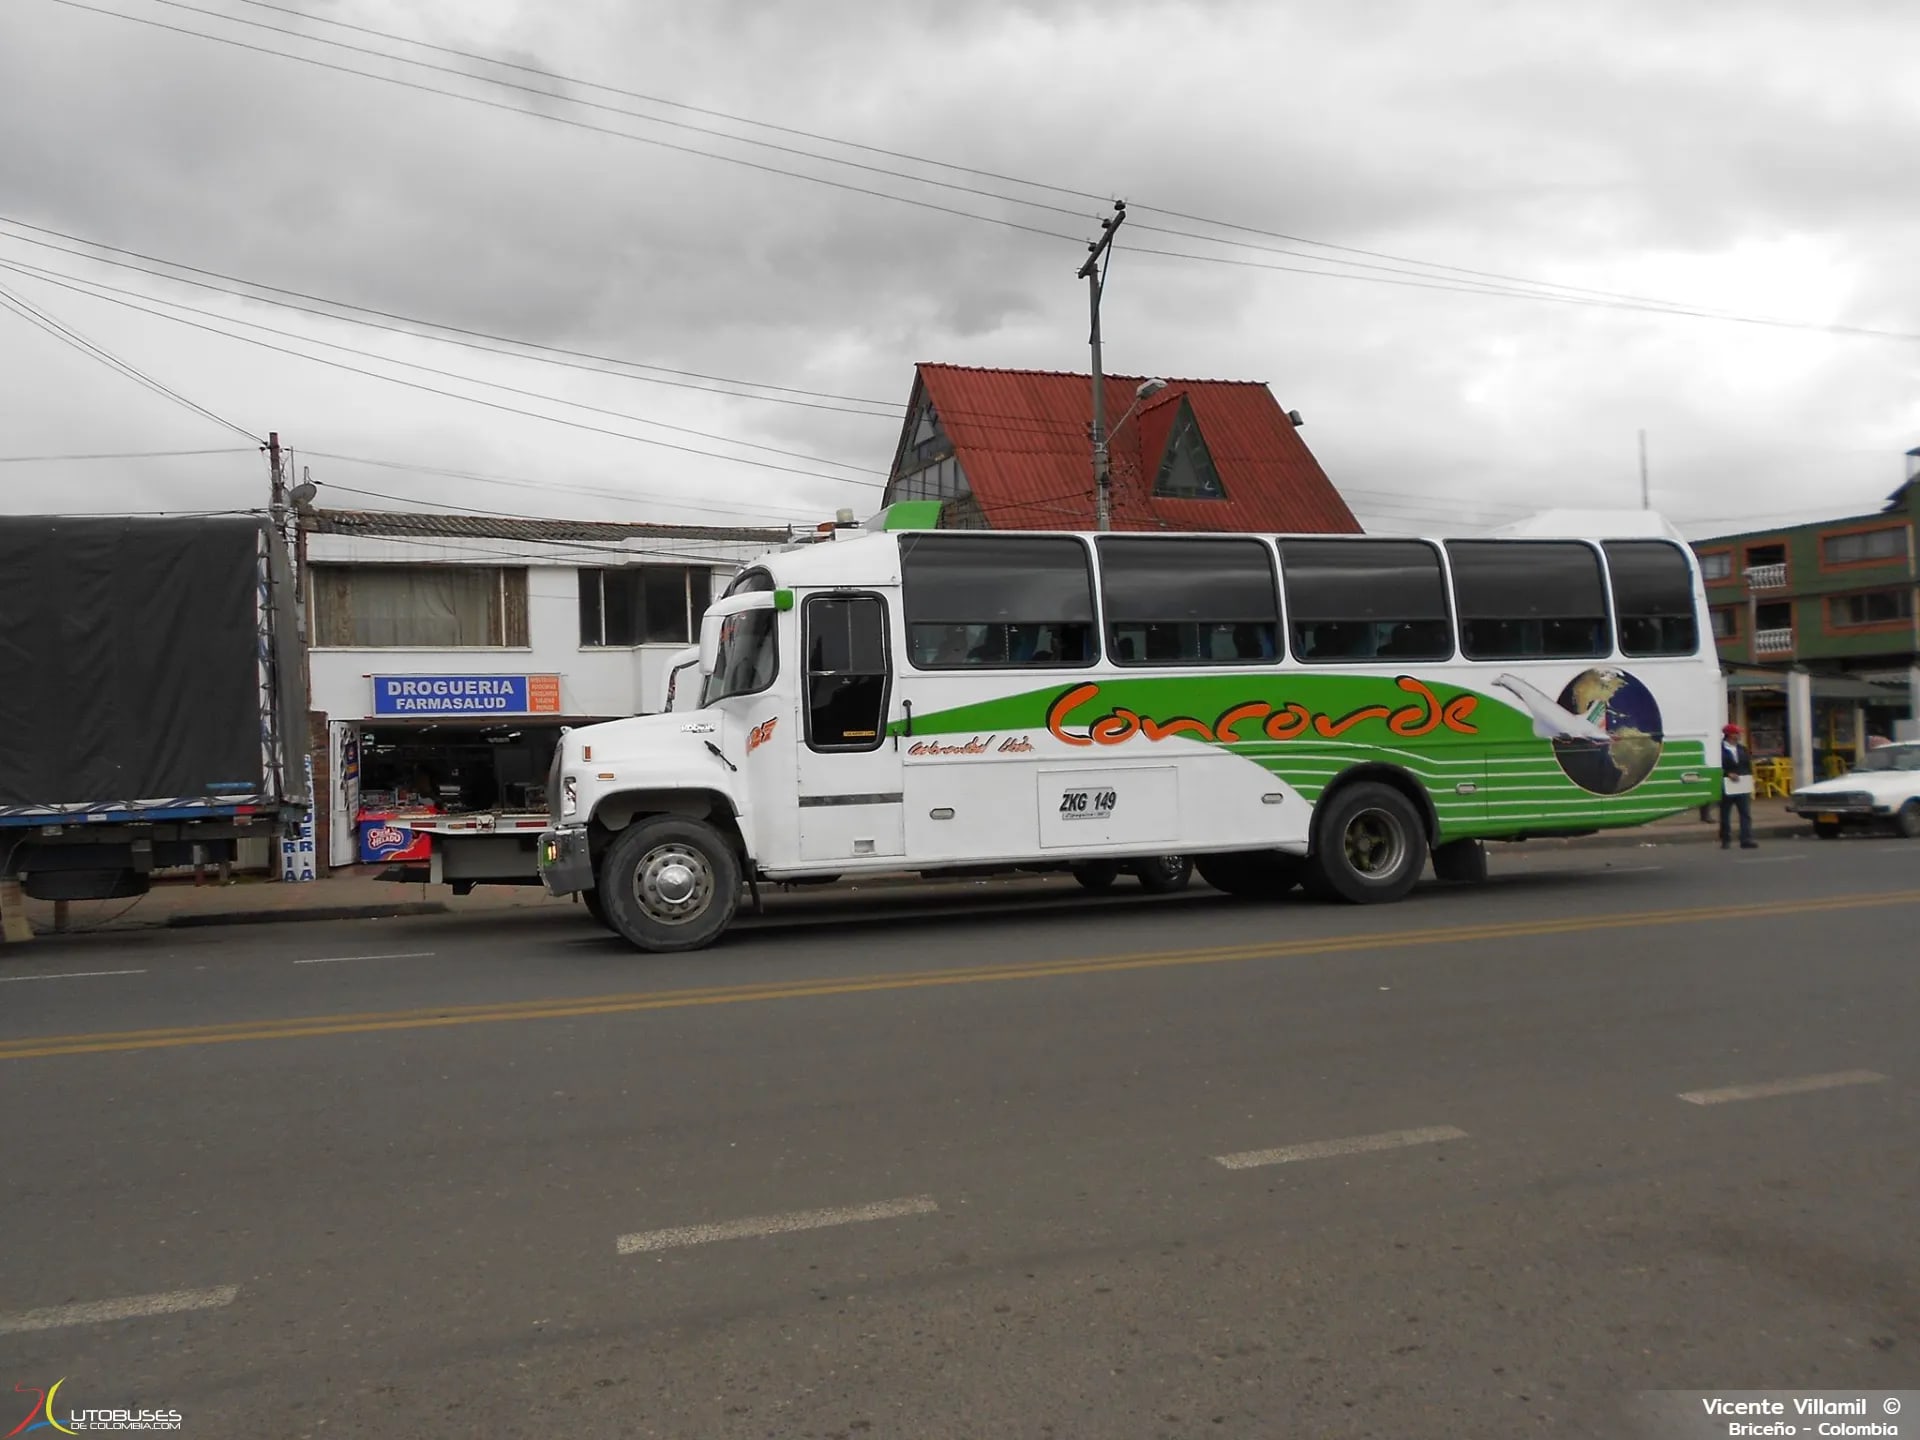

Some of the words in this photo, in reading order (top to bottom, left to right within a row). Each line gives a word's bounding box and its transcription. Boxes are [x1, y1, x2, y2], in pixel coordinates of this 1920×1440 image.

[387, 680, 514, 696] DROGUERIA
[396, 697, 507, 710] FARMASALUD
[1046, 675, 1478, 746] Concorde
[1059, 793, 1089, 811] ZKG
[1094, 791, 1116, 810] 149
